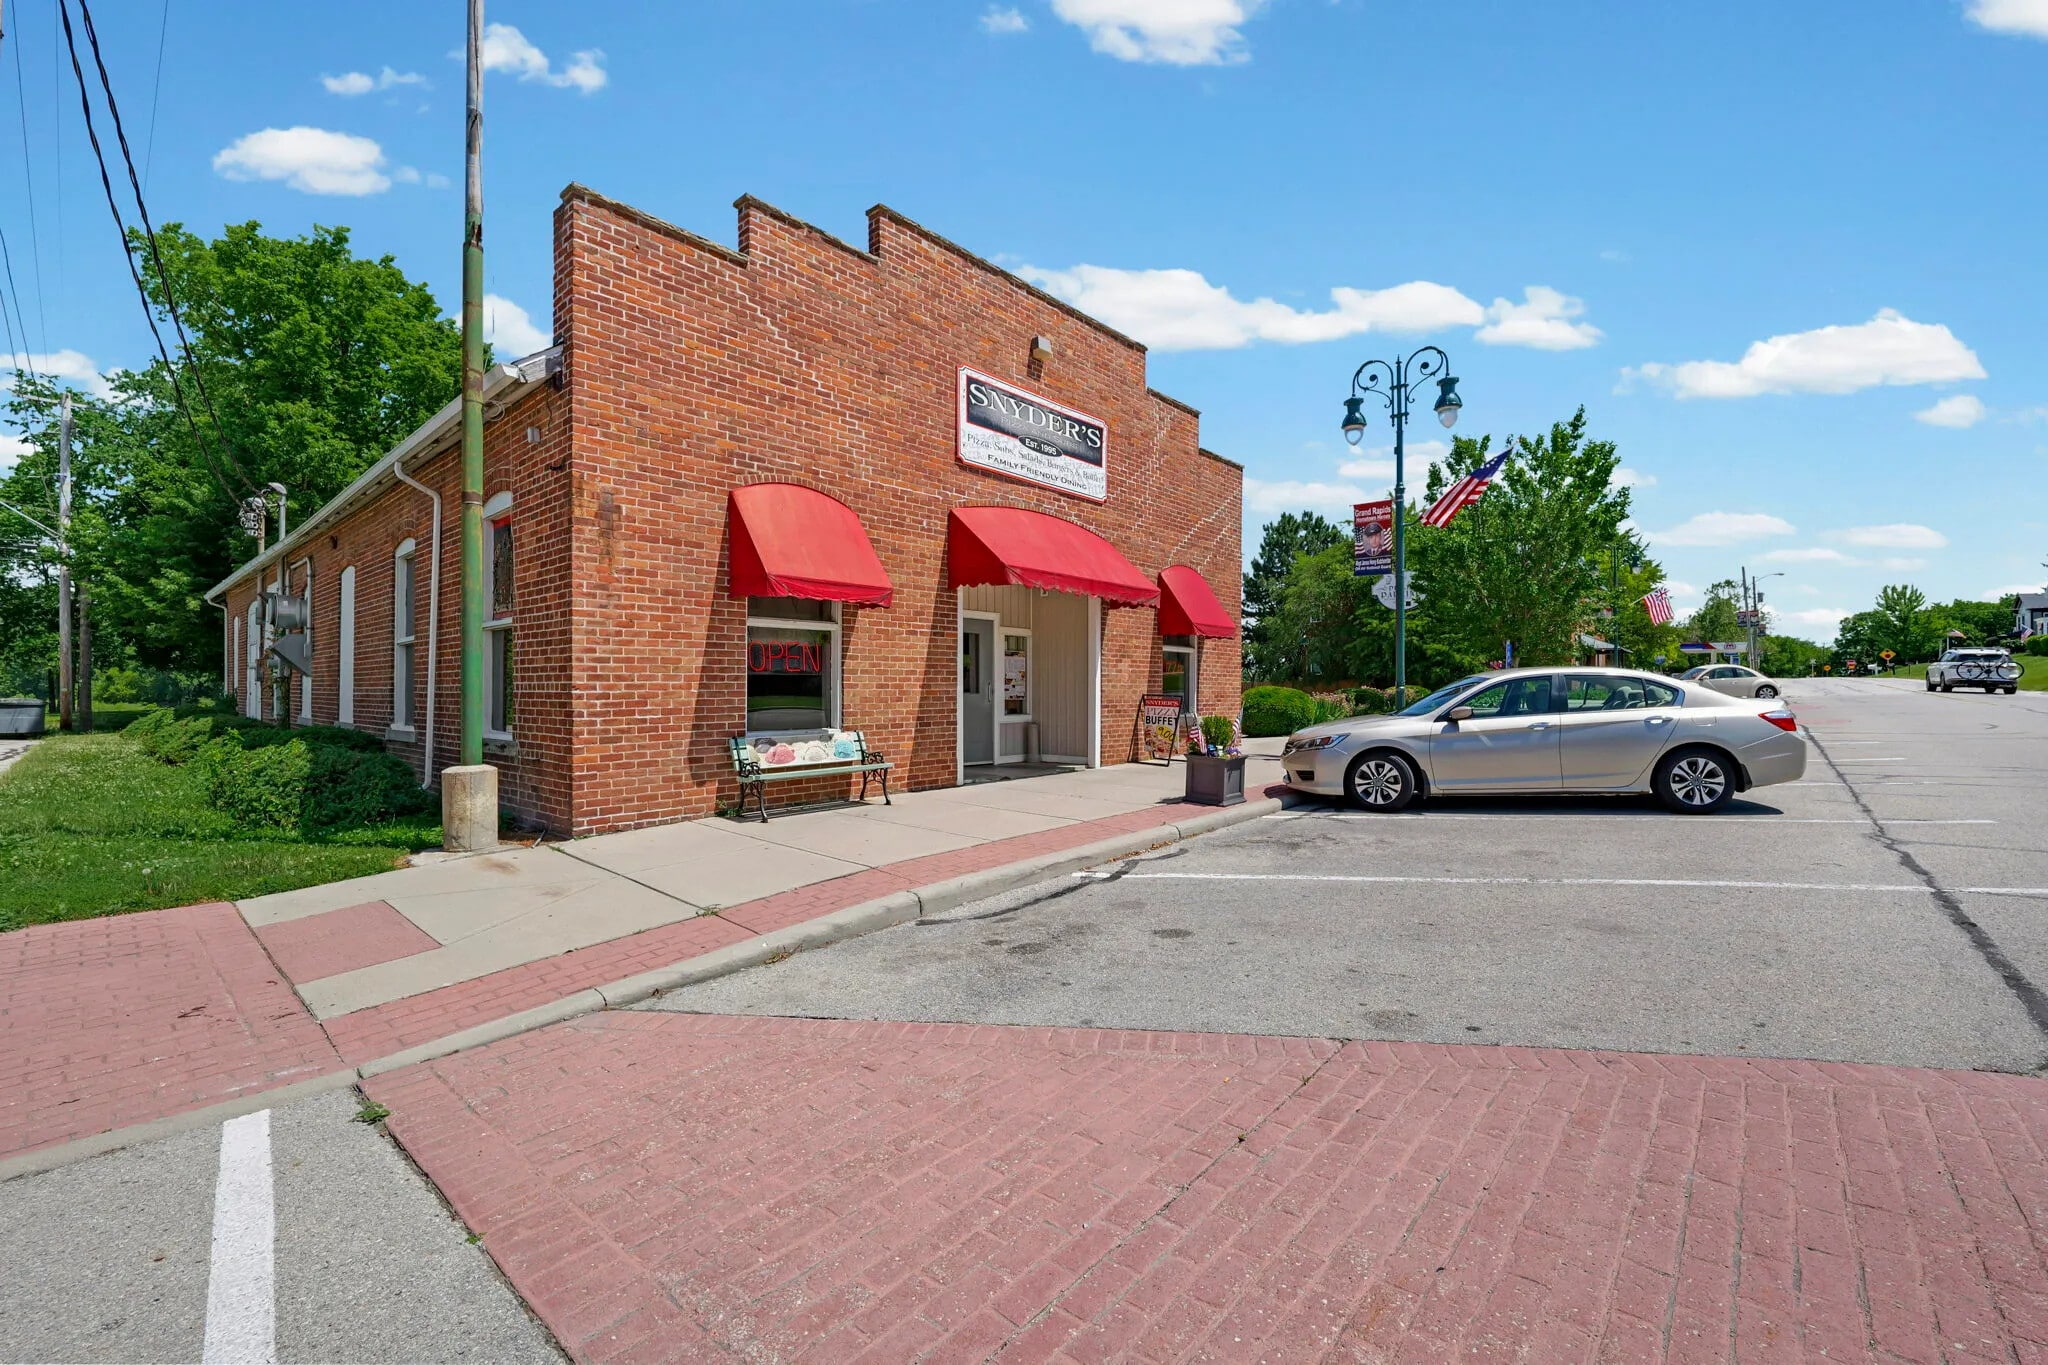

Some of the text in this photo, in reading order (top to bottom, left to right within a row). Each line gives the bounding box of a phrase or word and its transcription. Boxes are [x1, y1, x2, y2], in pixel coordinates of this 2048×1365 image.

[969, 383, 1101, 448] SNYDER'S
[1041, 443, 1057, 456] 1995
[987, 454, 1087, 490] FAMILY FRIENDLY DINING
[1355, 506, 1391, 518] Grand Rapids
[749, 640, 822, 672] OPEN
[1146, 707, 1178, 716] PIZZA
